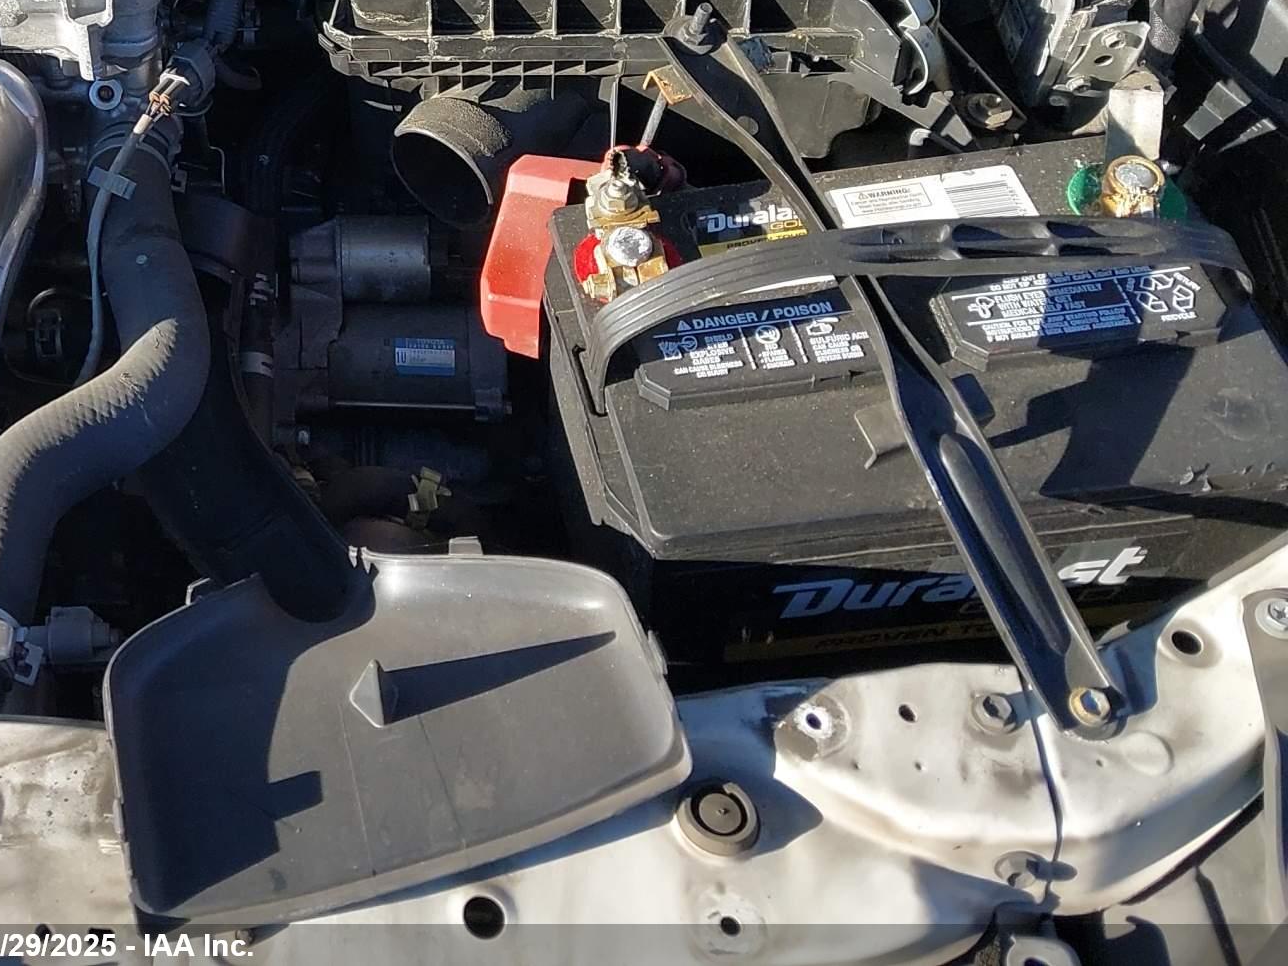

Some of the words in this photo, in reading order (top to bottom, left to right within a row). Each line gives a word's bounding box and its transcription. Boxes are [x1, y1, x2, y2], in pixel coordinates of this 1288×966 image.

[994, 291, 1022, 304] FLUSH
[1023, 288, 1046, 301] EYES
[692, 310, 758, 330] DANGER
[775, 301, 833, 319] POISON
[1002, 305, 1042, 318] MEDICAL
[1064, 301, 1086, 311] FAST
[809, 332, 850, 345] SULFURIC
[689, 347, 735, 359] EXPLOSIVE
[772, 546, 1146, 619] Durast
